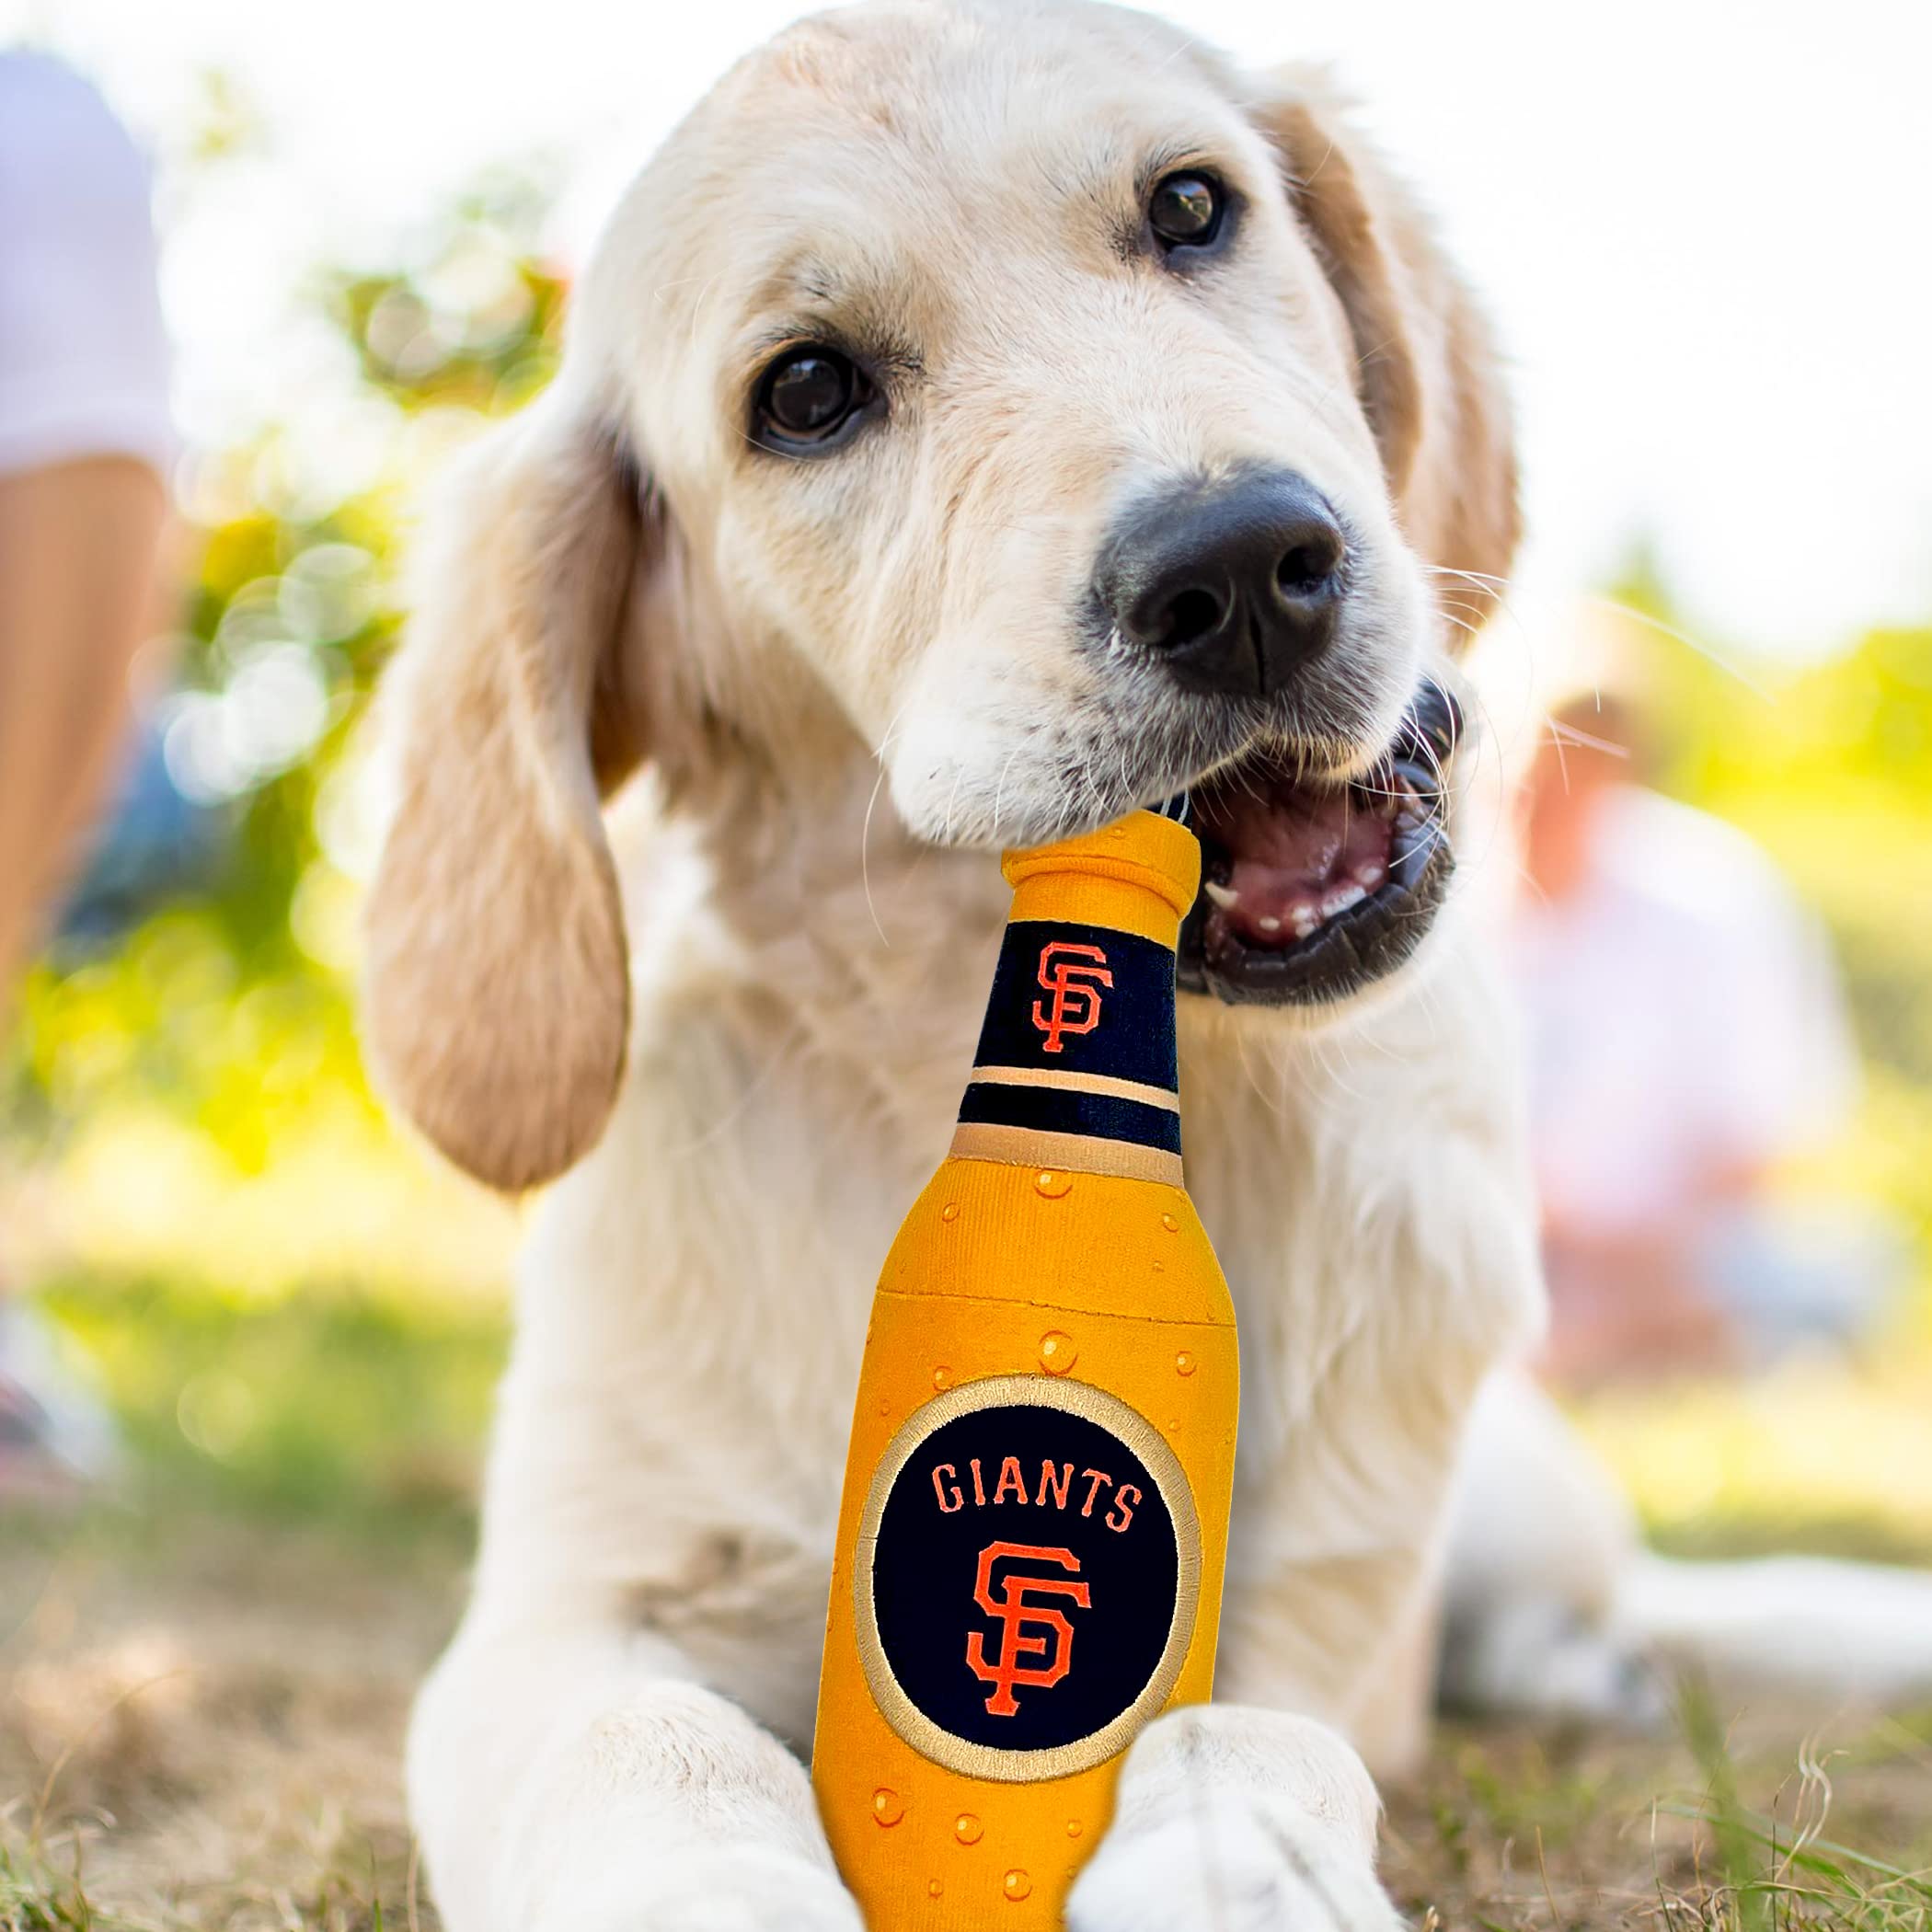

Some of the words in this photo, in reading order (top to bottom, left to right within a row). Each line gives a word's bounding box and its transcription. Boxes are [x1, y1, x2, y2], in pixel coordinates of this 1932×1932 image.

[1031, 941, 1114, 1053] SF
[931, 1456, 1144, 1533] GIANTS
[965, 1540, 1092, 1717] SF
